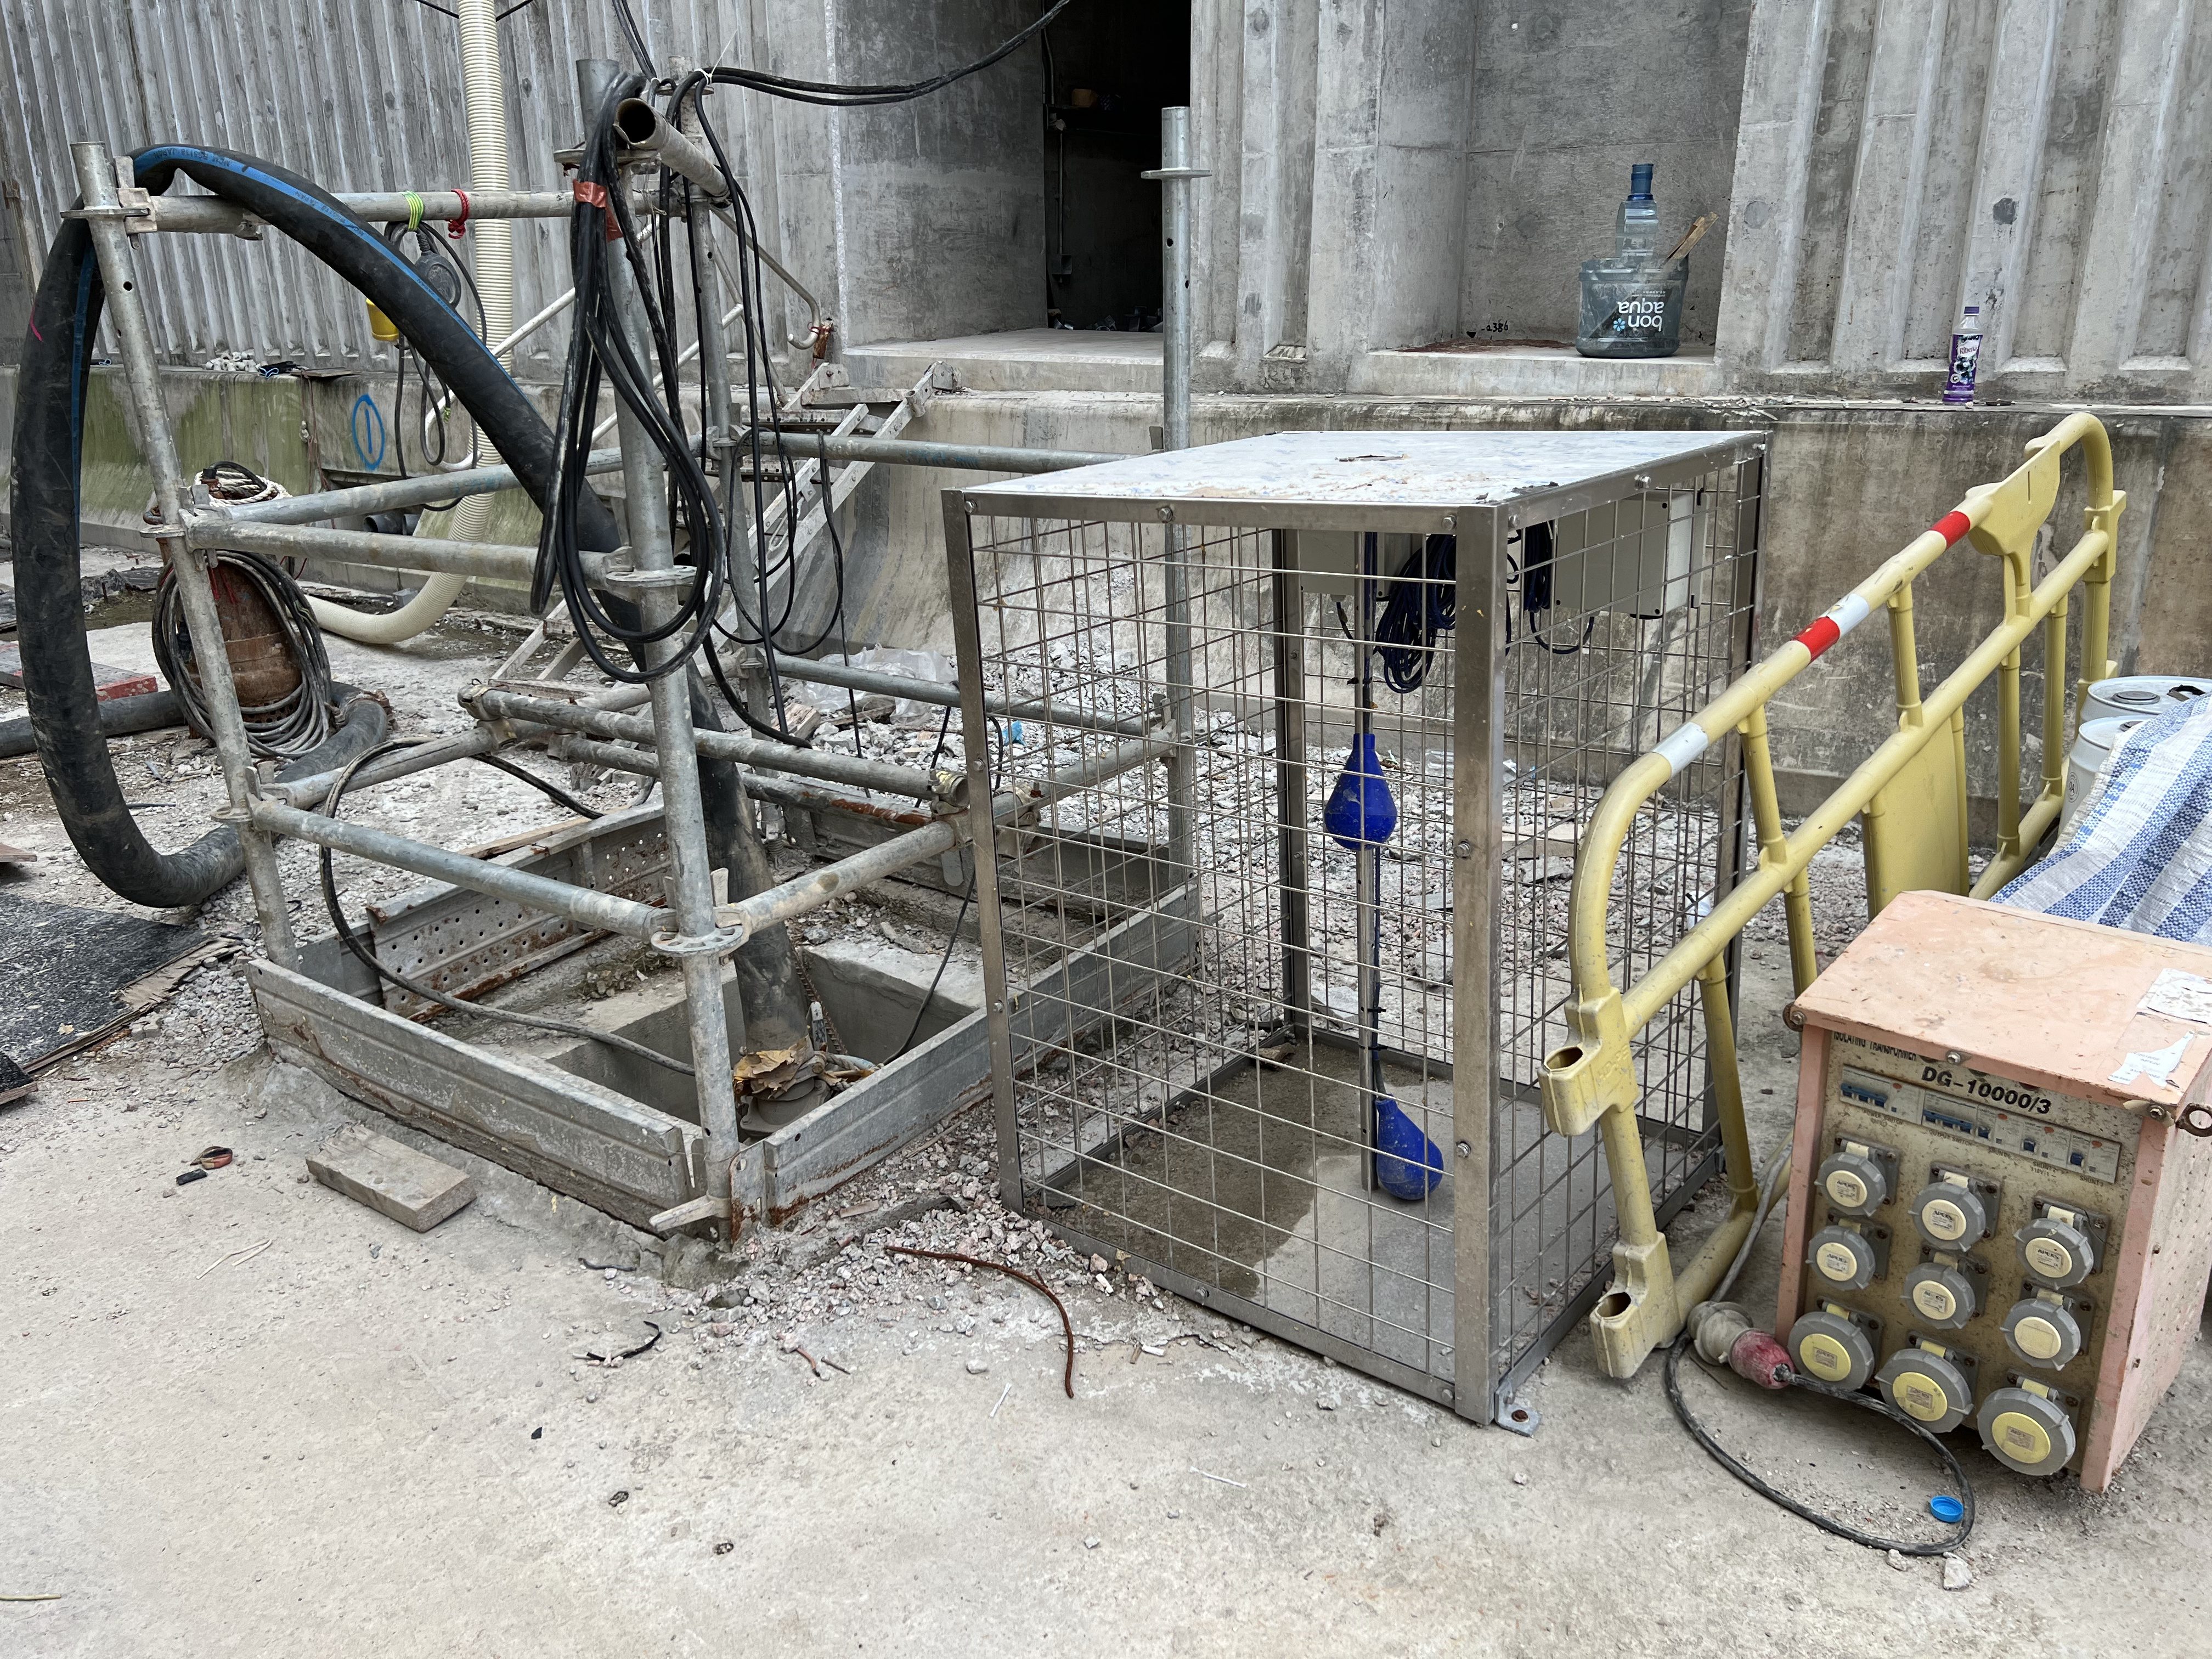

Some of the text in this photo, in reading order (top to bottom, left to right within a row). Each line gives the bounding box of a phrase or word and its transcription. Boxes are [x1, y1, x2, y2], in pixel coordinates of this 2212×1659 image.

[1617, 297, 1665, 314] aqua
[1628, 315, 1663, 332] bon
[1959, 346, 1977, 355] Ribena
[1921, 1066, 2051, 1114] DG-10000/3
